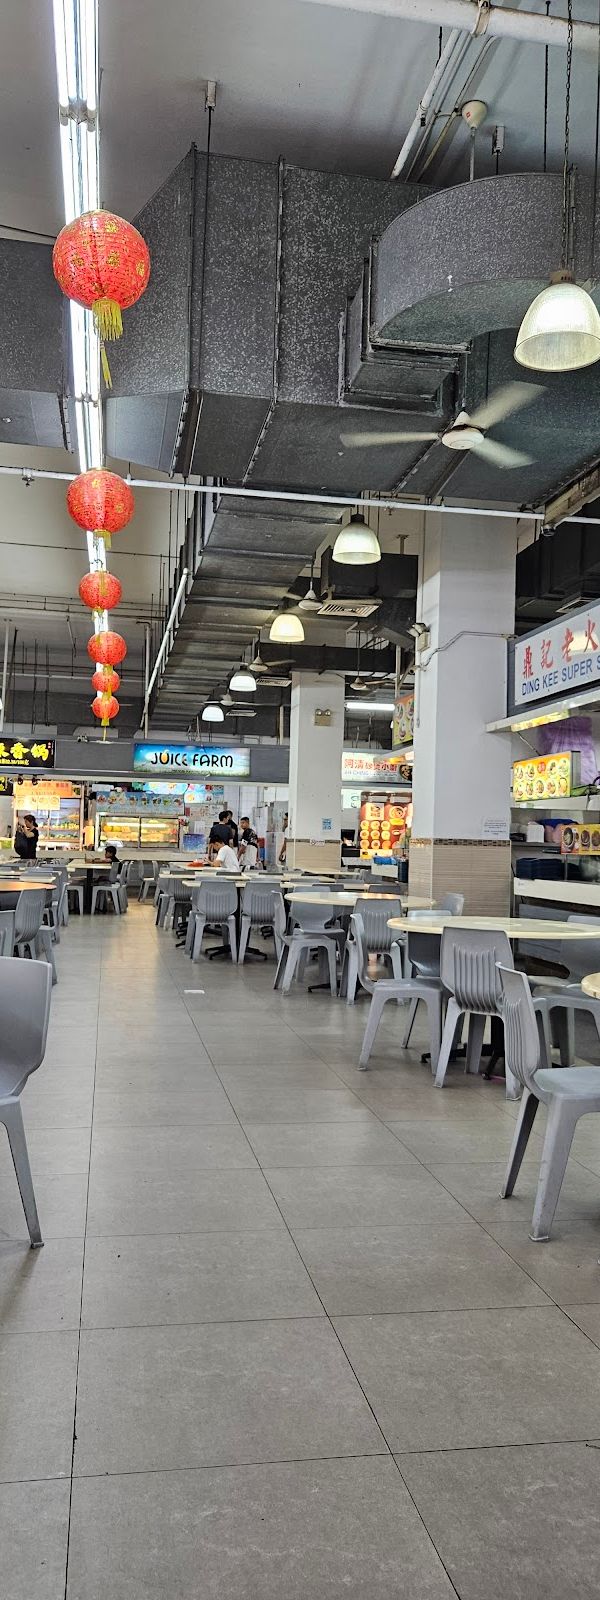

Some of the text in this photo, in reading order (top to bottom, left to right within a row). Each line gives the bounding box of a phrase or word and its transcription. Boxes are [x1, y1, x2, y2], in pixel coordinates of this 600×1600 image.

[521, 677, 540, 696] DING
[542, 670, 559, 689] KEE
[561, 658, 593, 682] SUPER
[150, 751, 233, 768] JUICE FARM
